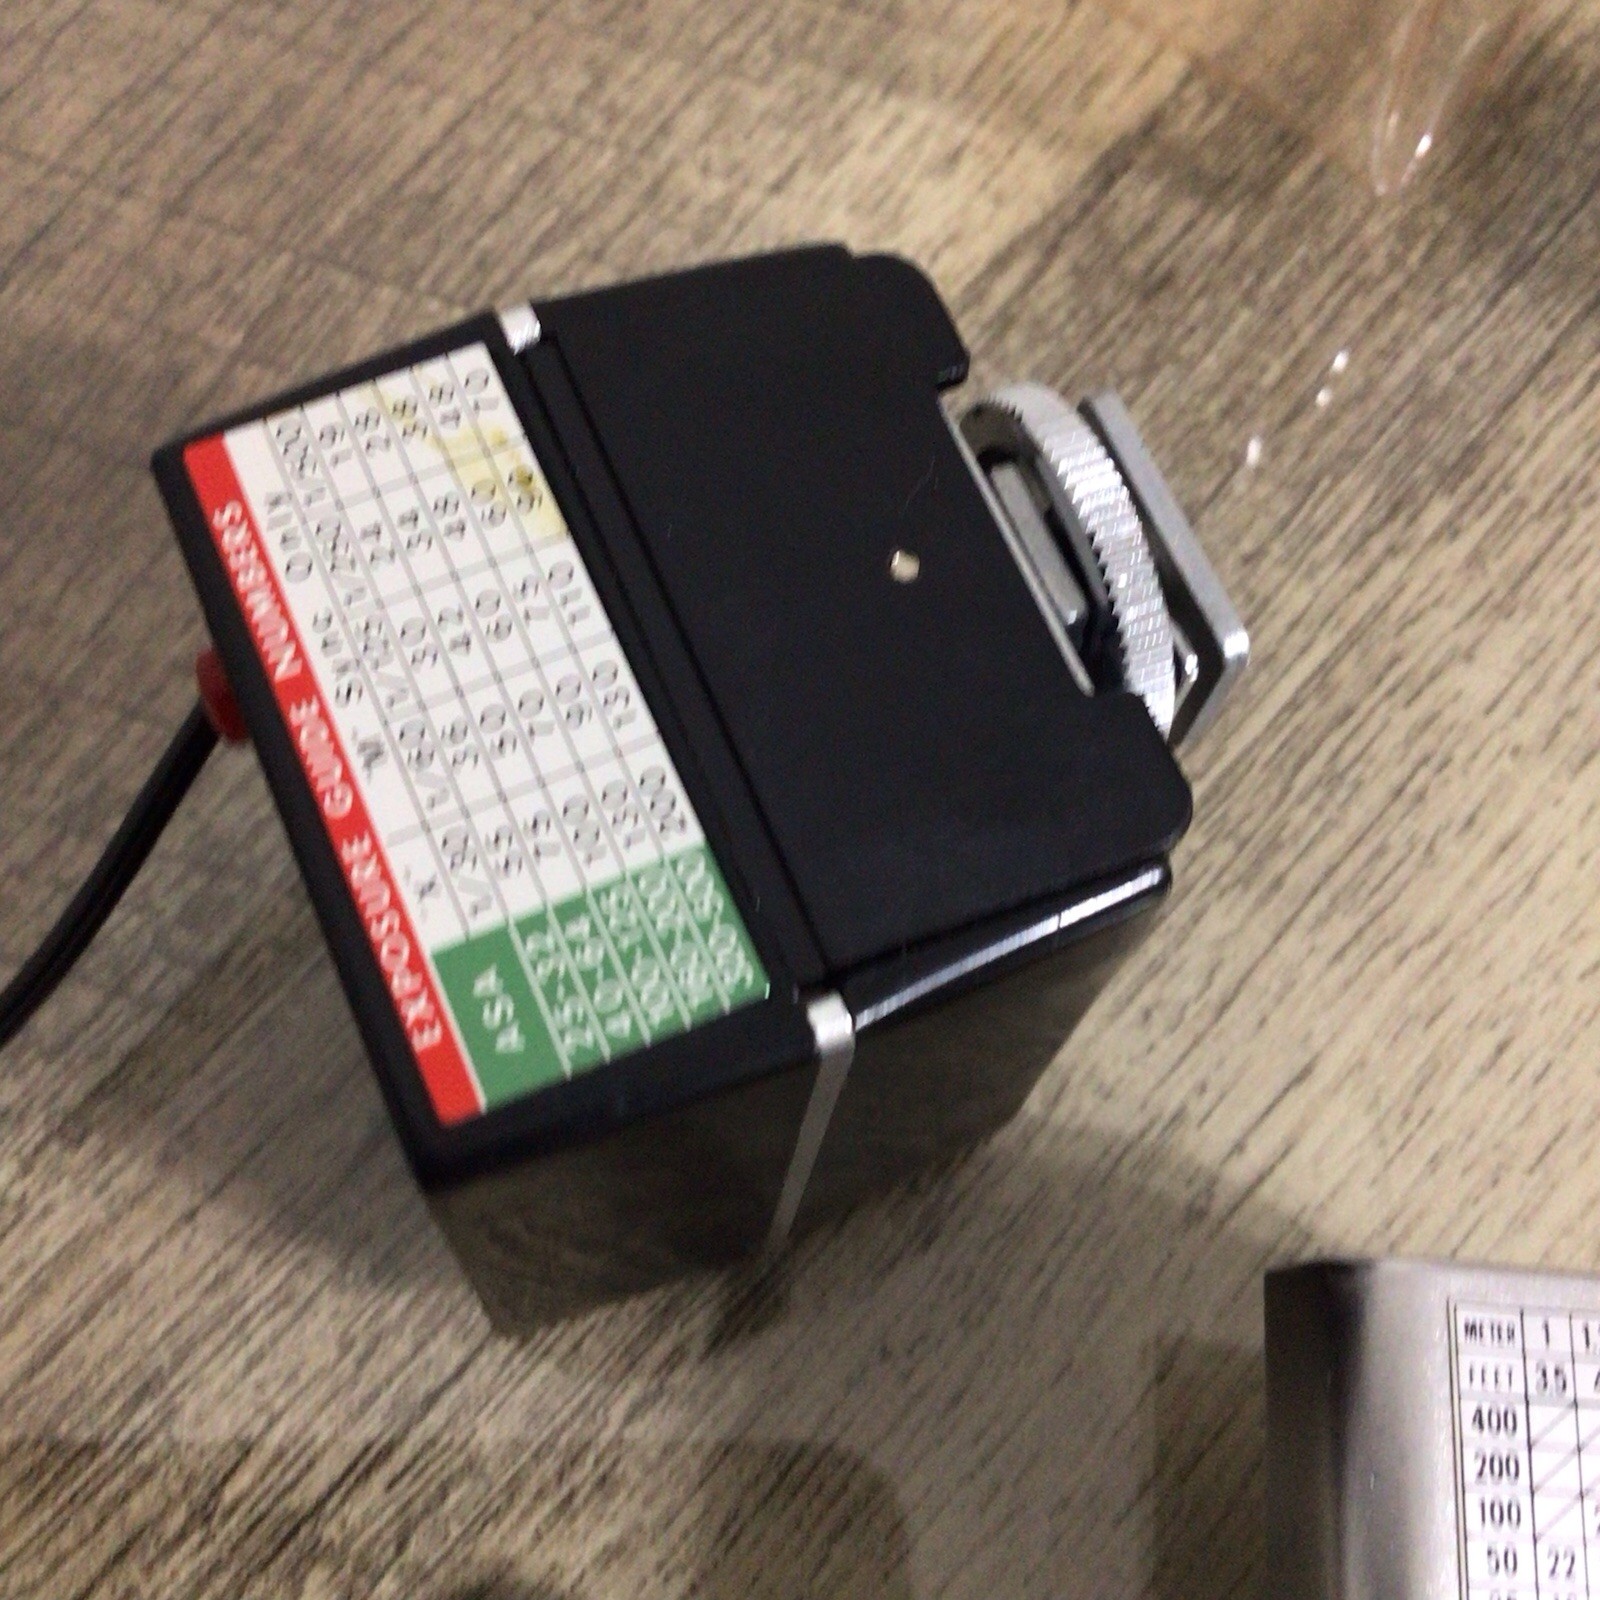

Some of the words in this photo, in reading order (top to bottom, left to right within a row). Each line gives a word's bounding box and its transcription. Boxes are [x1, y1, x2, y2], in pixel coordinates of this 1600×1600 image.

[386, 395, 429, 445] 38
[427, 380, 464, 430] 48
[462, 367, 500, 421] 70
[317, 421, 354, 469] 19
[352, 406, 393, 458] 28
[396, 504, 434, 557] 34
[430, 489, 468, 543] 48
[469, 477, 508, 529] 60
[264, 485, 324, 584] Only
[358, 520, 398, 572] 24
[212, 500, 303, 683] NUMBERS
[474, 589, 514, 644] 60
[511, 573, 552, 630] 75
[546, 560, 591, 628] 110
[311, 602, 374, 709] Sync
[398, 617, 439, 672] 30
[436, 603, 473, 657] 42
[516, 688, 556, 745] 70
[554, 674, 594, 731] 90
[590, 659, 637, 733] 130
[288, 694, 354, 819] GUIDE
[439, 717, 481, 775] 36
[477, 704, 519, 761] 50
[397, 718, 451, 812] 1/60
[561, 795, 607, 868] 100
[637, 766, 689, 842] 200
[483, 824, 524, 881] 55
[521, 808, 562, 867] 75
[440, 826, 494, 921] 1/30
[340, 830, 443, 1053] EXPOSURE
[523, 924, 598, 1058] 25-32
[564, 910, 635, 1039] 40-64
[472, 963, 526, 1054] ASA
[1463, 1319, 1516, 1349] METER
[1543, 1318, 1551, 1348] 1
[1471, 1401, 1519, 1437] 400
[1473, 1446, 1521, 1486] 200
[1478, 1495, 1523, 1532] 100
[1486, 1541, 1519, 1579] 50
[1546, 1543, 1577, 1580] 22
